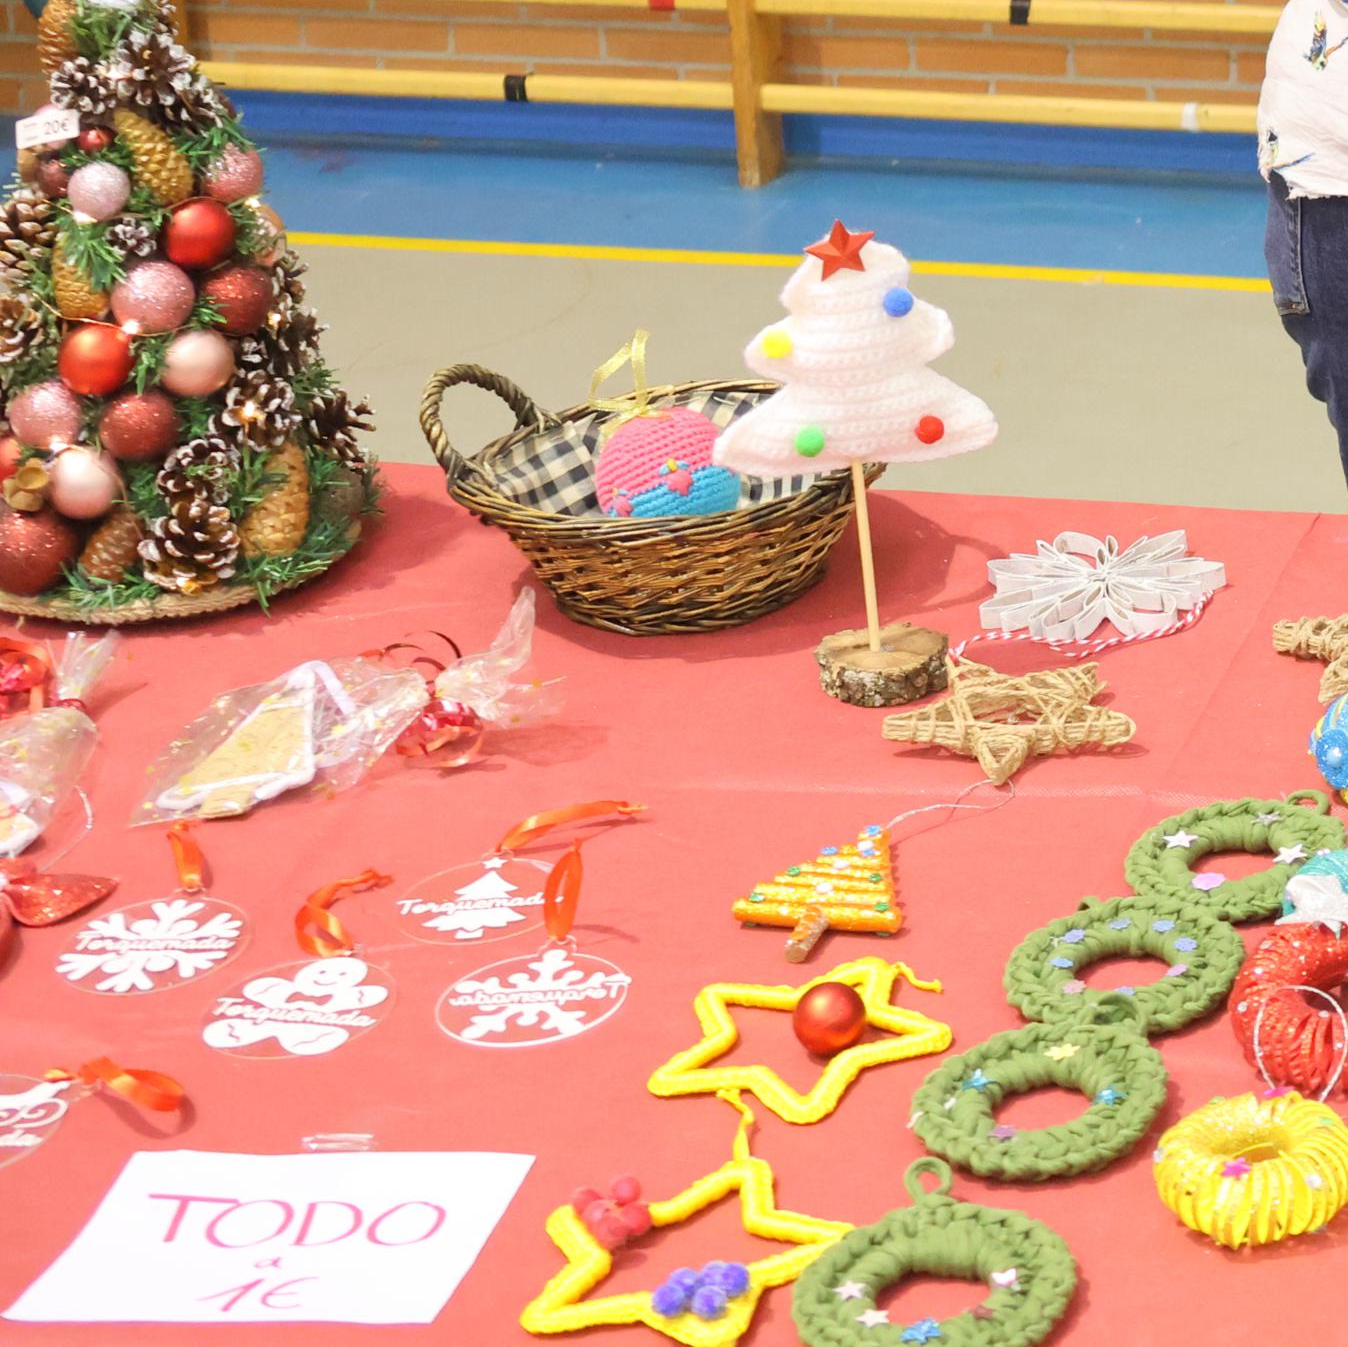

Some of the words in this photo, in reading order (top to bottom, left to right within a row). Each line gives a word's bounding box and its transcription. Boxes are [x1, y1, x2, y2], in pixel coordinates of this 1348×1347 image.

[44, 118, 71, 134] 20€
[396, 891, 563, 917] Torquemad
[75, 934, 236, 952] Torquemada
[212, 997, 378, 1028] Torquemada
[148, 1193, 447, 1248] TODO
[252, 1255, 283, 1269] a
[196, 1276, 319, 1312] 1€
